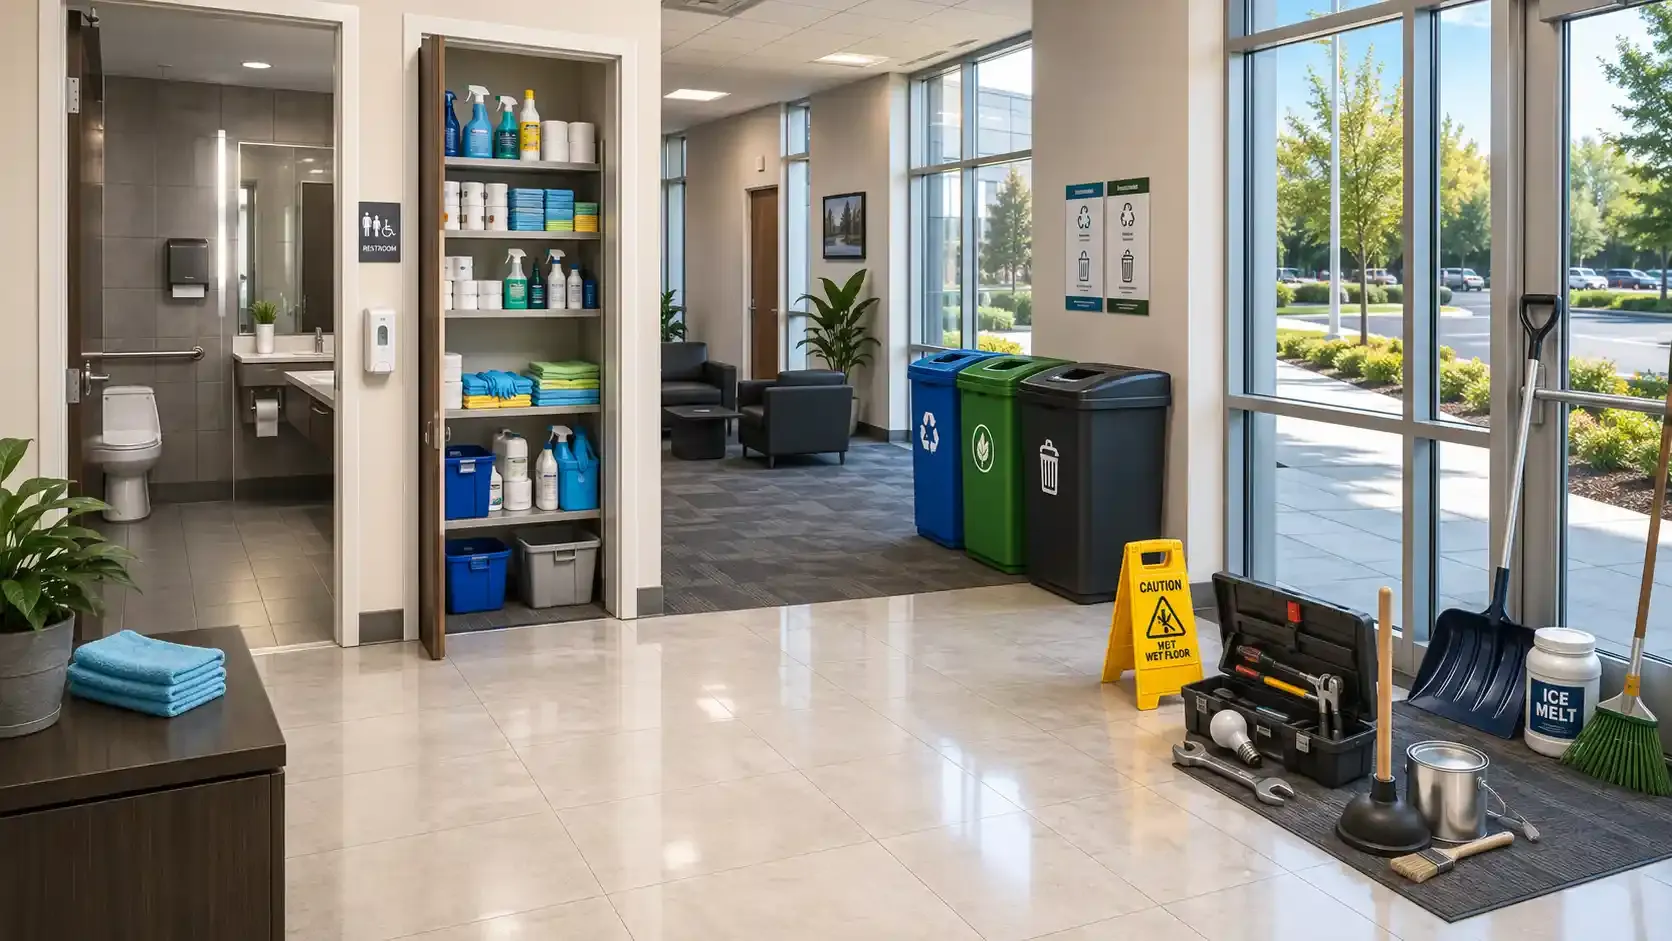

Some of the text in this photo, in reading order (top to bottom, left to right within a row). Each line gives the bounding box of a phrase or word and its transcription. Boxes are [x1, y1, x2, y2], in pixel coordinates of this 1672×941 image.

[1140, 579, 1182, 593] CAUTION
[1145, 648, 1191, 661] WET FLOOR
[1543, 688, 1569, 706] ICE
[1536, 702, 1577, 723] MELT
